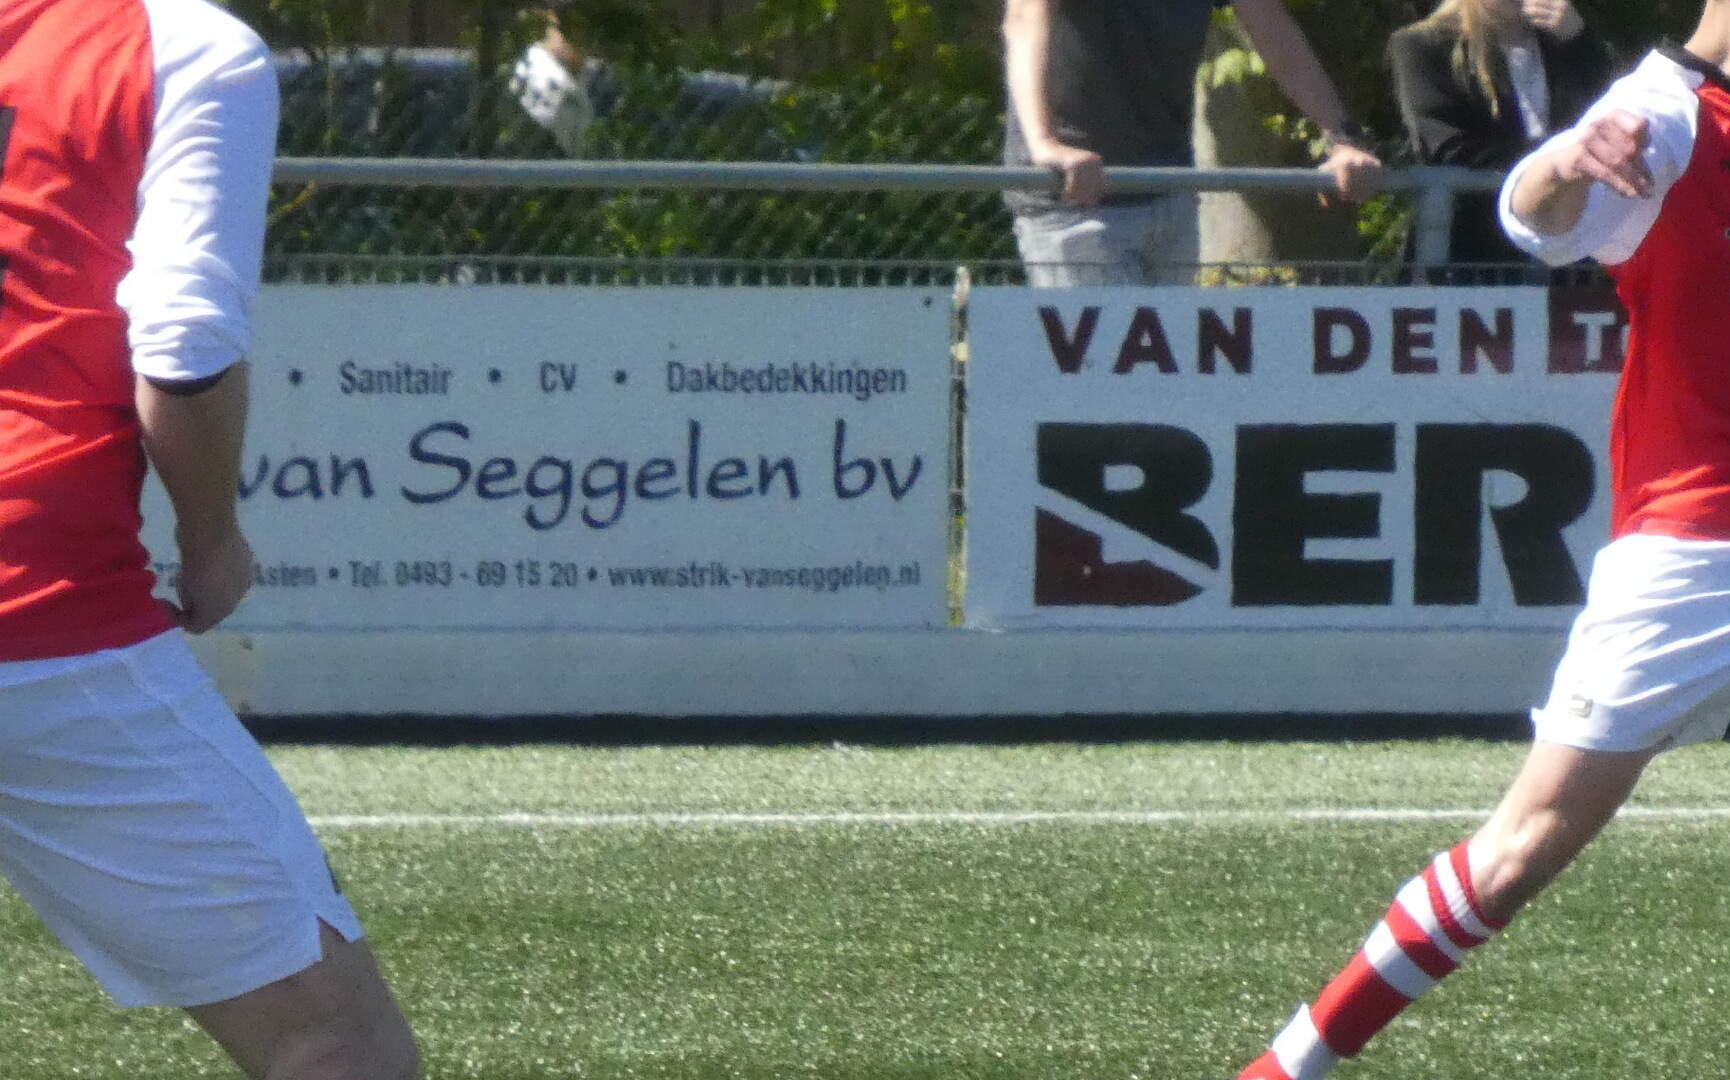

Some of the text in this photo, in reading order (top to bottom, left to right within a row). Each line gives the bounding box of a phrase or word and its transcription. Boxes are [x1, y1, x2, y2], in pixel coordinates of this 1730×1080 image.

[1039, 306, 1253, 374] VAN
[1313, 307, 1513, 374] DEN
[340, 361, 907, 400] Sanitair CV Dakbedekkingen
[401, 420, 800, 532] Seggelen
[833, 418, 924, 501] bv
[1034, 422, 1597, 607] BER
[548, 561, 578, 587] 20
